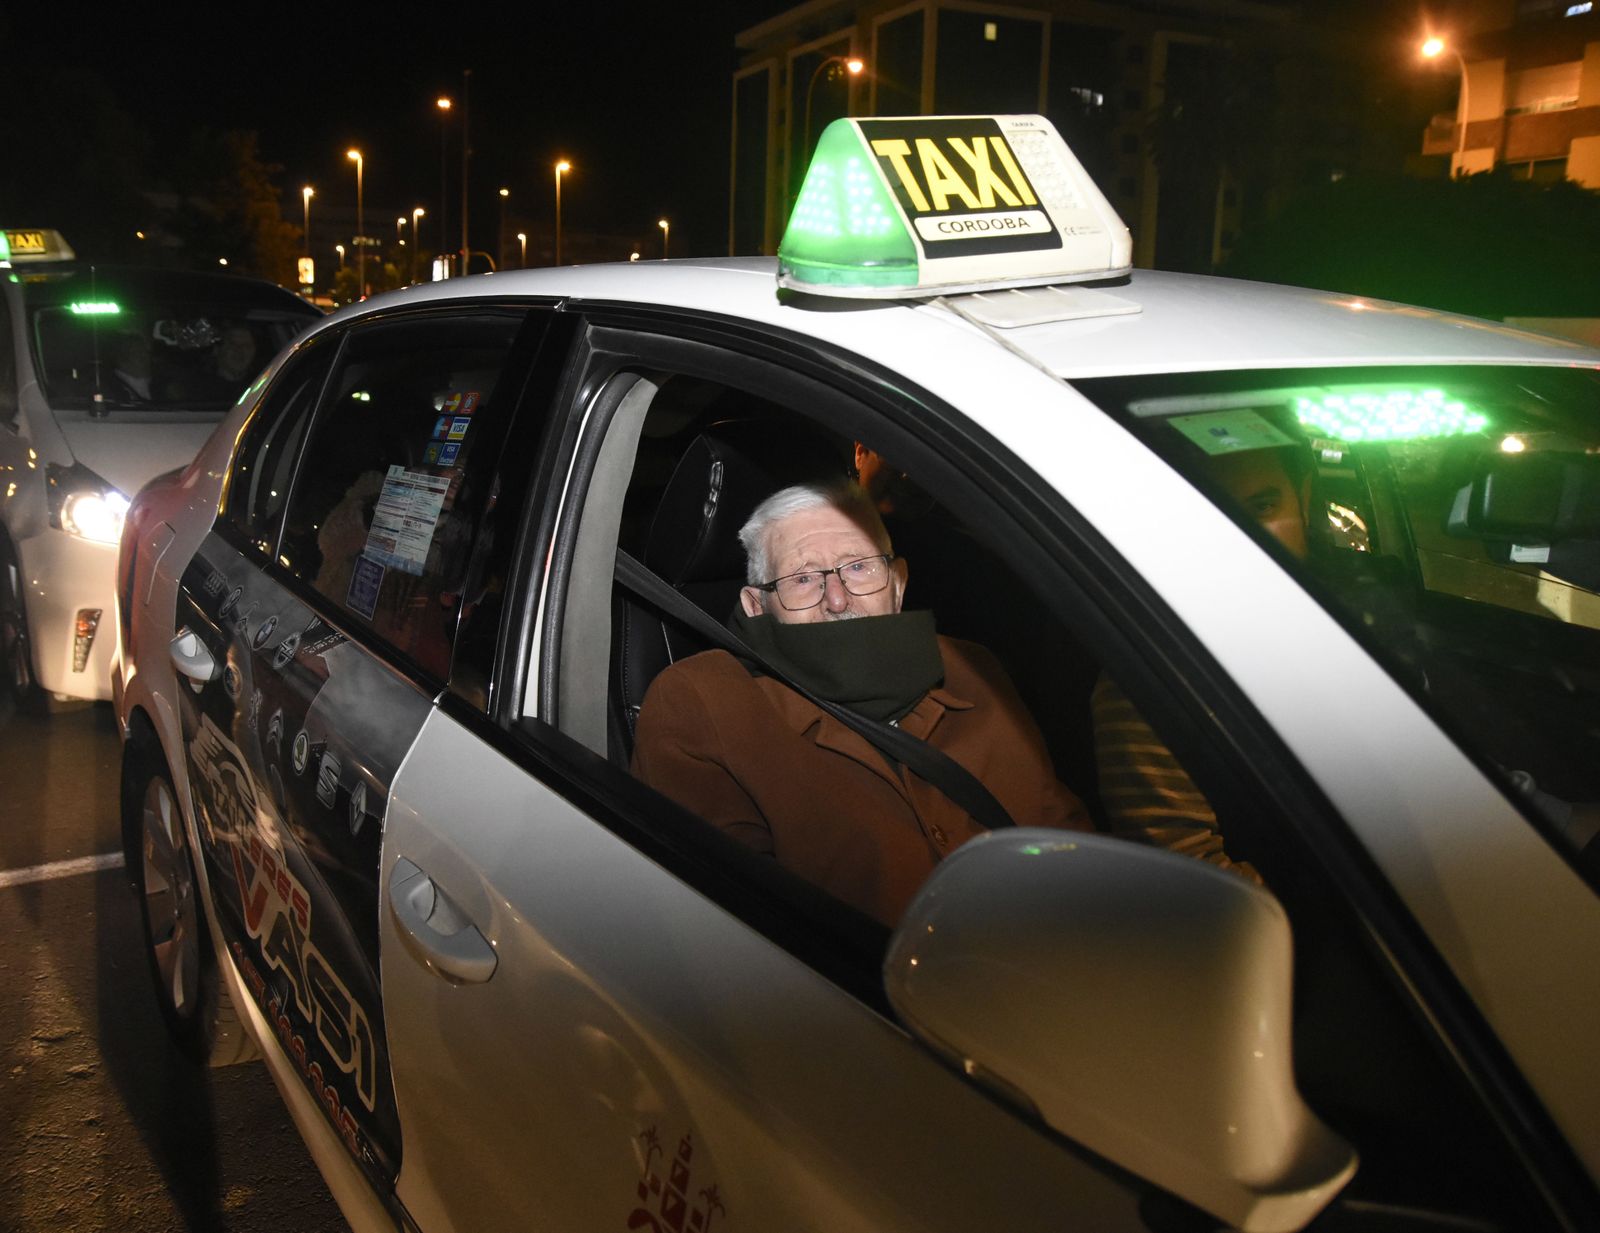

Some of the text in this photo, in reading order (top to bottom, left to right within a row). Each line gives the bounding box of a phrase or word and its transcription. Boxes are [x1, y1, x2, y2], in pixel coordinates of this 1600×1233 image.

[872, 137, 1037, 211] TAXI
[937, 216, 1032, 235] CORDOBA
[8, 233, 43, 248] TAXI
[451, 423, 466, 433] VISA
